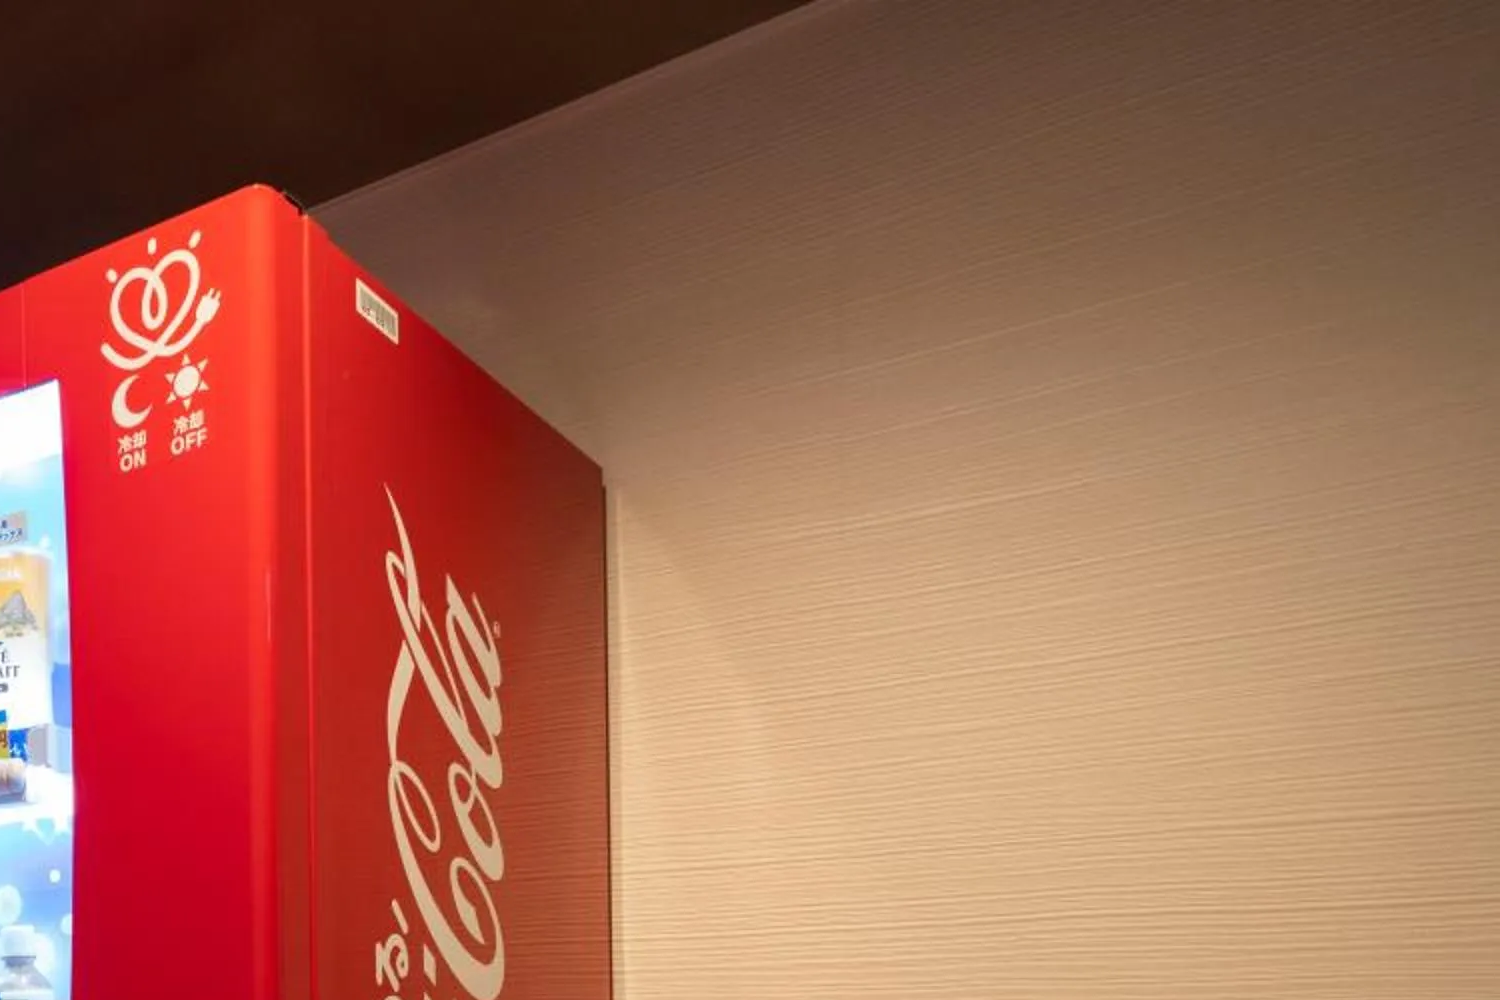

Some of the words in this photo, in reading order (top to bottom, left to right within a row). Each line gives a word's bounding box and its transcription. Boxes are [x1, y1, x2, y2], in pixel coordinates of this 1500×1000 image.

[173, 409, 204, 437] 冷却
[117, 430, 147, 457] 冷却
[170, 427, 208, 456] OFF
[120, 448, 147, 473] ON
